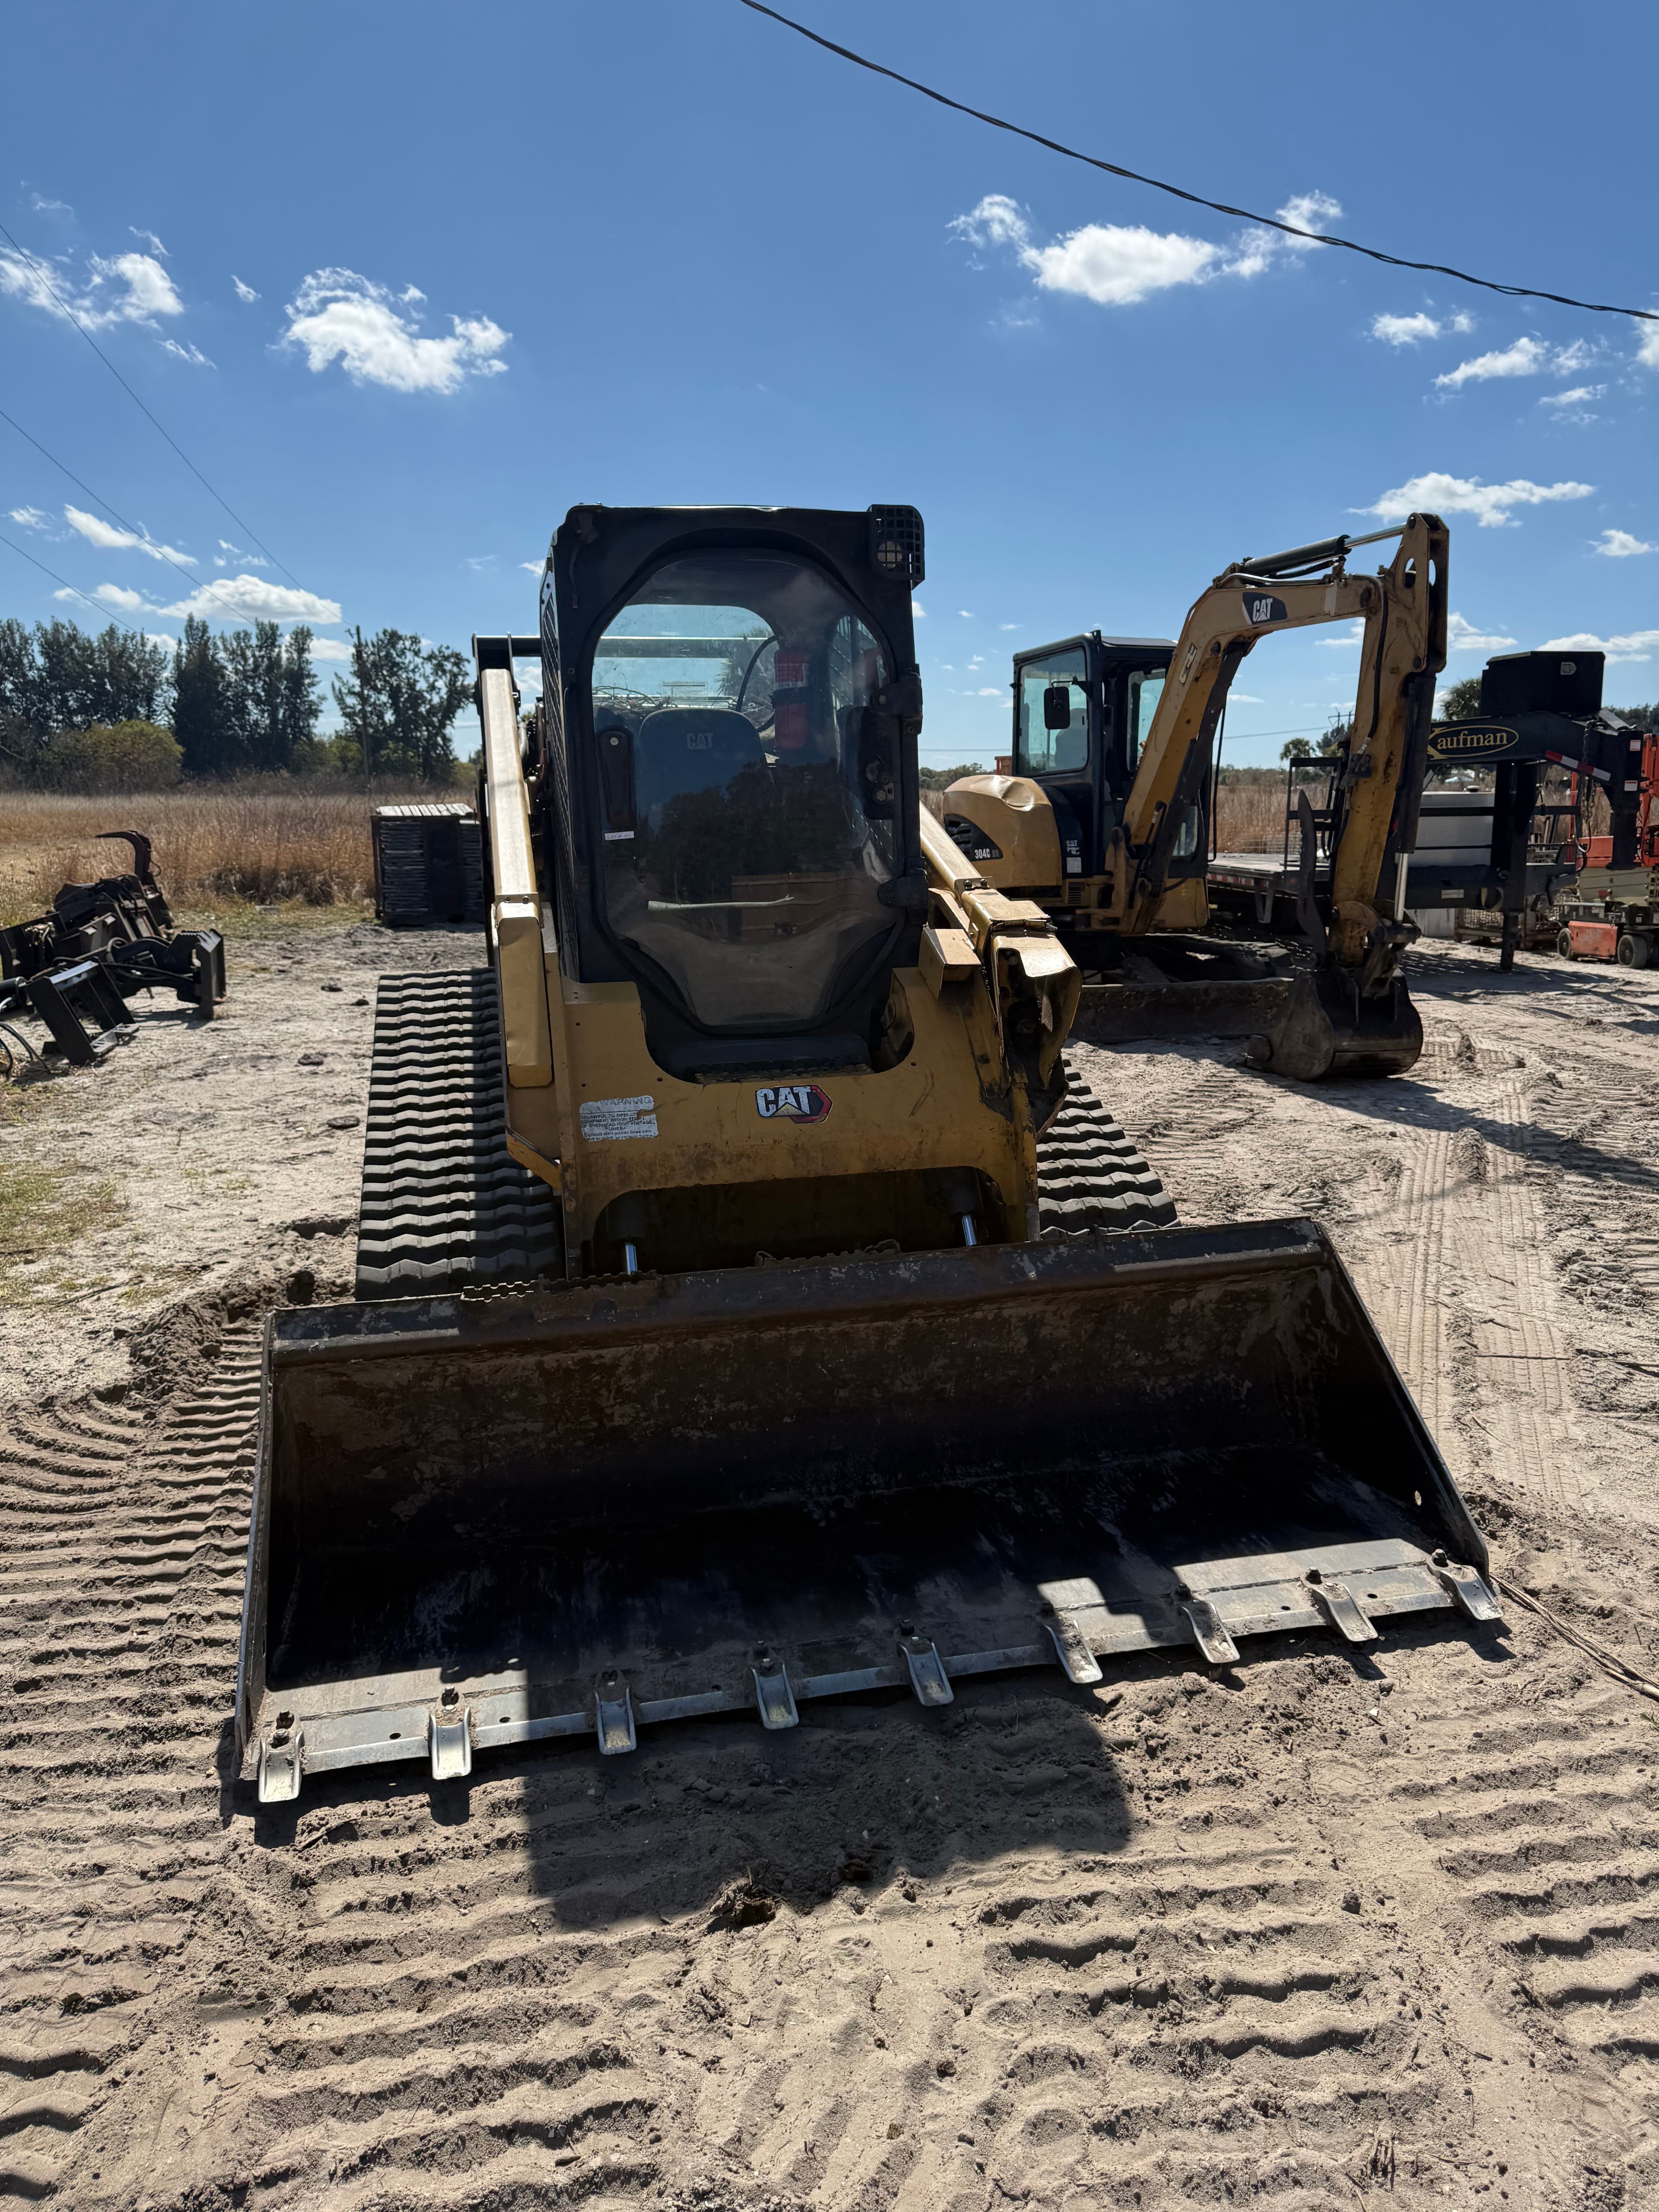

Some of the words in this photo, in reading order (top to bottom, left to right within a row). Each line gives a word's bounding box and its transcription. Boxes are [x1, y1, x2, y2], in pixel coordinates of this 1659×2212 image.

[1252, 598, 1273, 622] CAT
[686, 733, 713, 750] CAT
[975, 849, 990, 859] 304C
[756, 1086, 811, 1117] CAT
